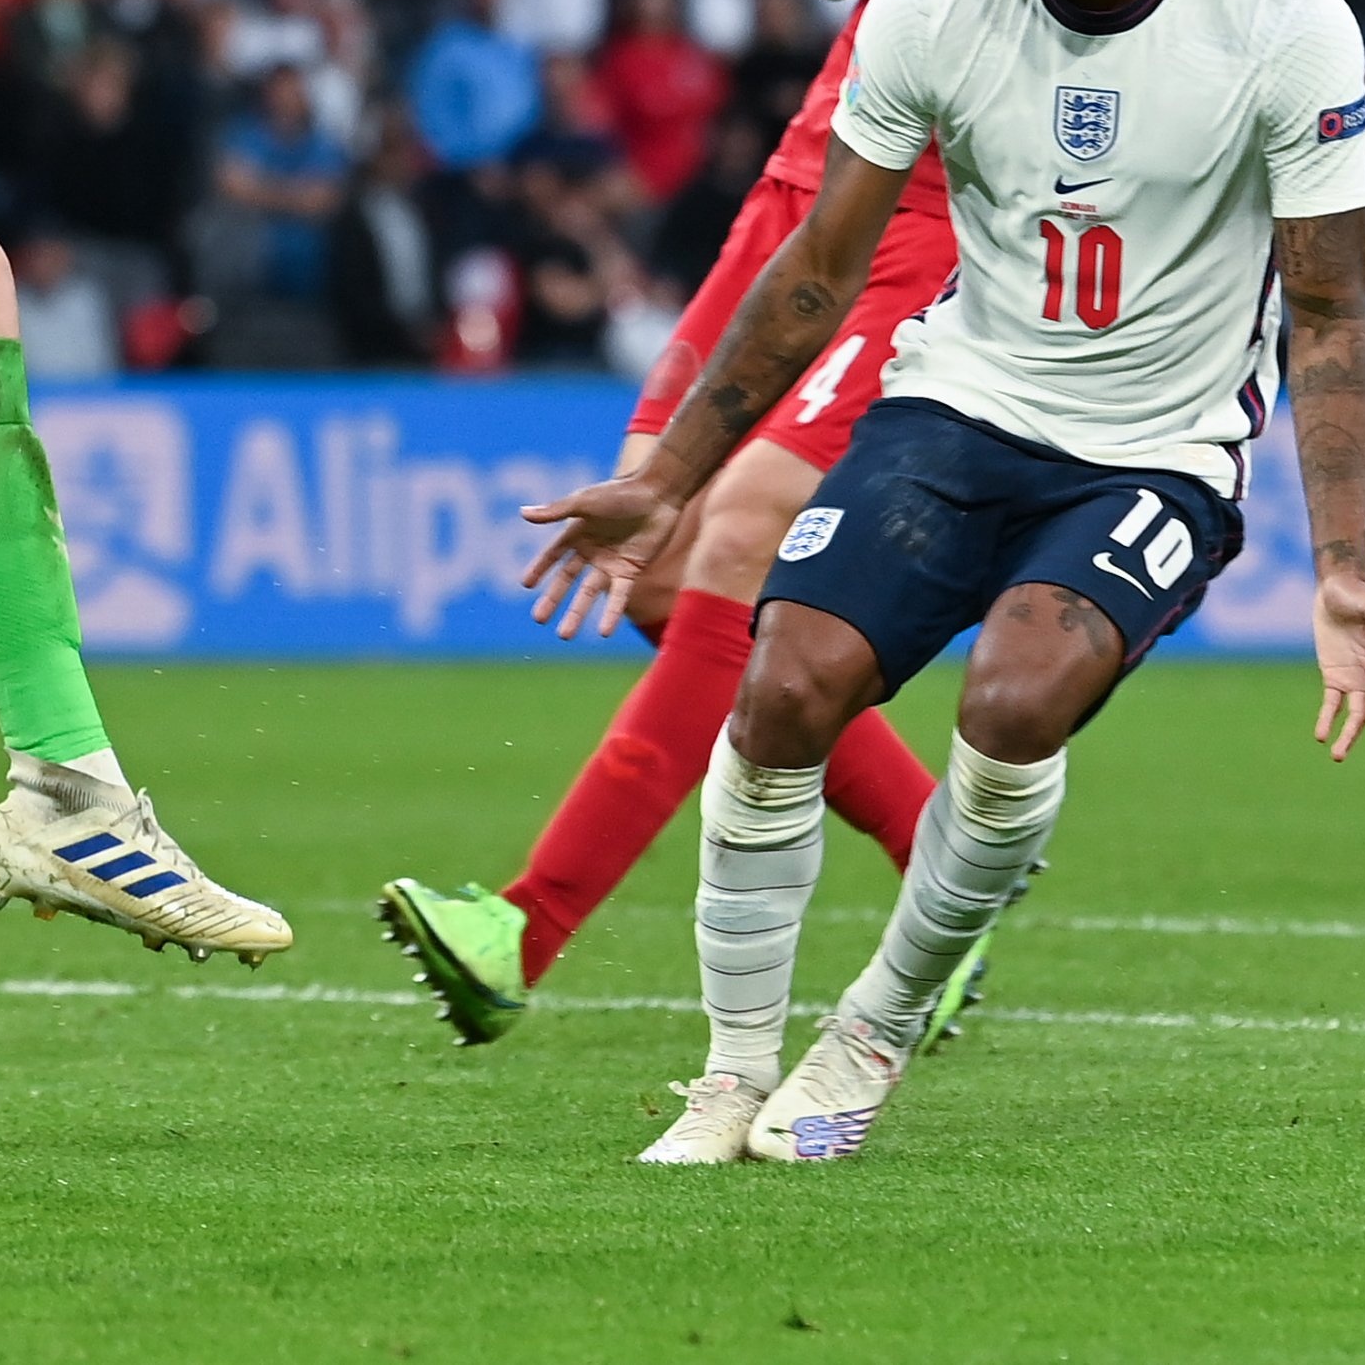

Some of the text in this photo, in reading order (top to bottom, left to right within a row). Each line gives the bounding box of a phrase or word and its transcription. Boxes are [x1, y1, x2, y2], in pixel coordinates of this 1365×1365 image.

[1039, 218, 1123, 330] 10
[795, 334, 867, 424] 4
[212, 417, 601, 637] Alipa
[1108, 487, 1195, 591] 10
